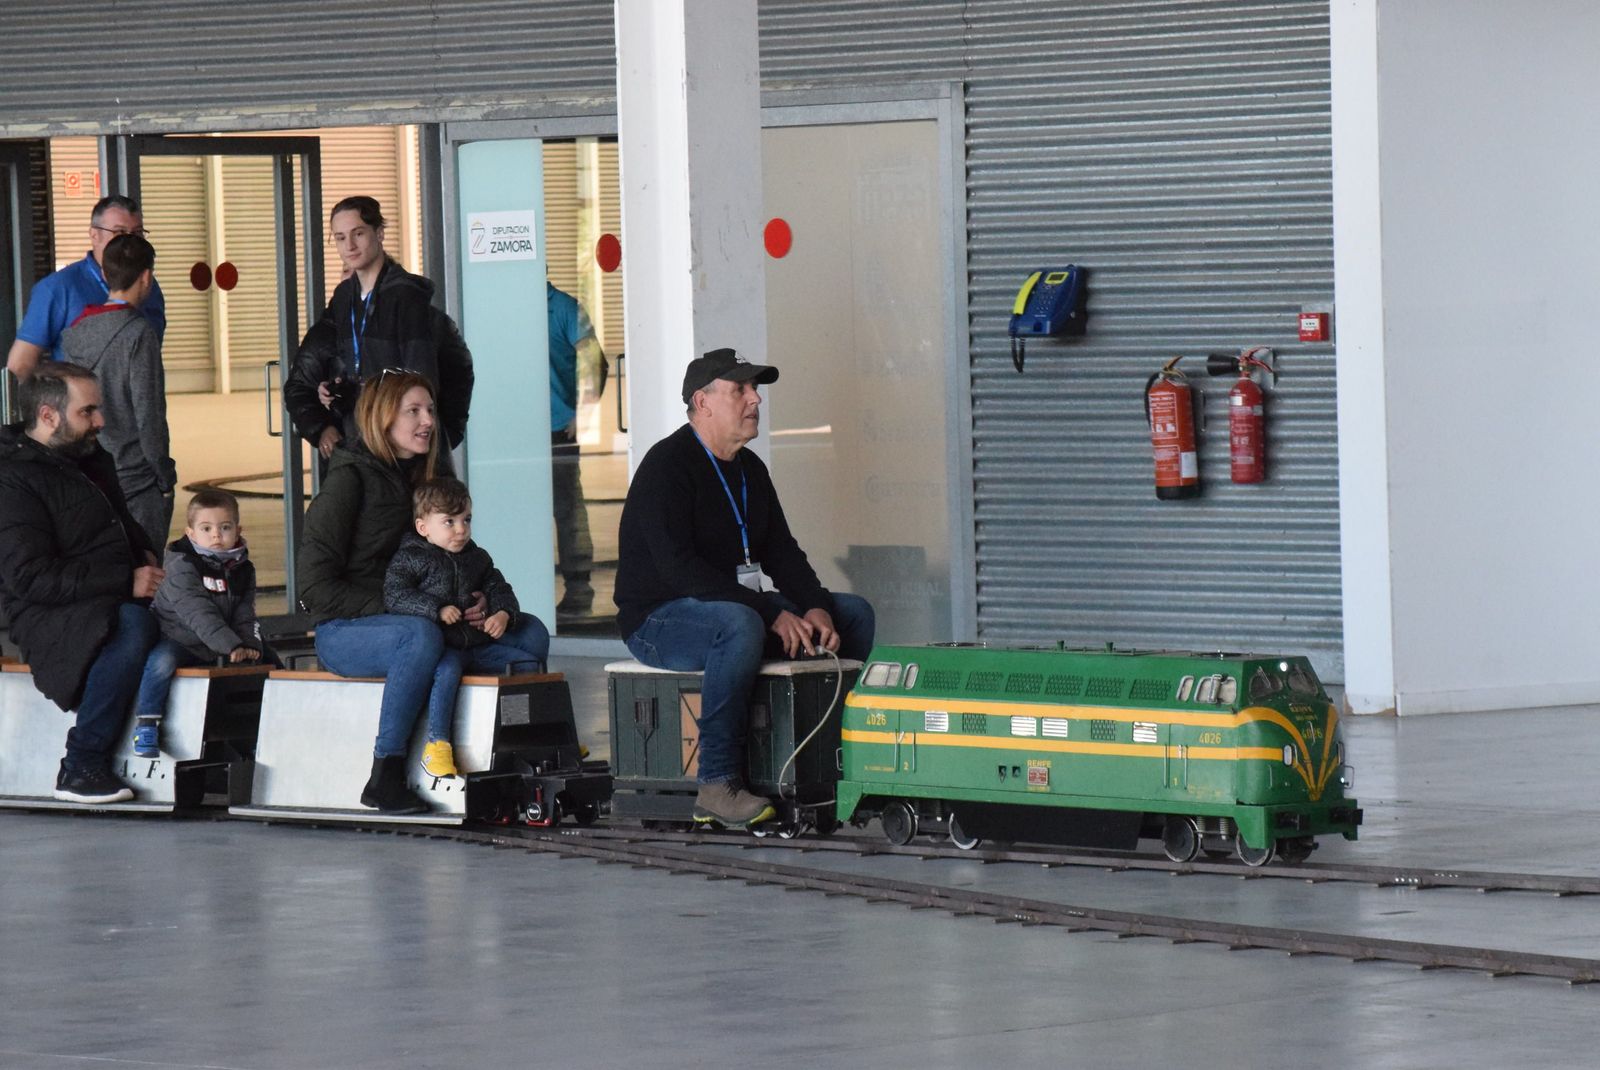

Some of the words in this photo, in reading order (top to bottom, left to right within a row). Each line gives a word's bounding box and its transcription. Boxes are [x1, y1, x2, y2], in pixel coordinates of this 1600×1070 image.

[490, 240, 533, 253] ZAMORA
[866, 713, 887, 726] 4026
[1199, 732, 1221, 744] 4026
[903, 761, 909, 771] 2
